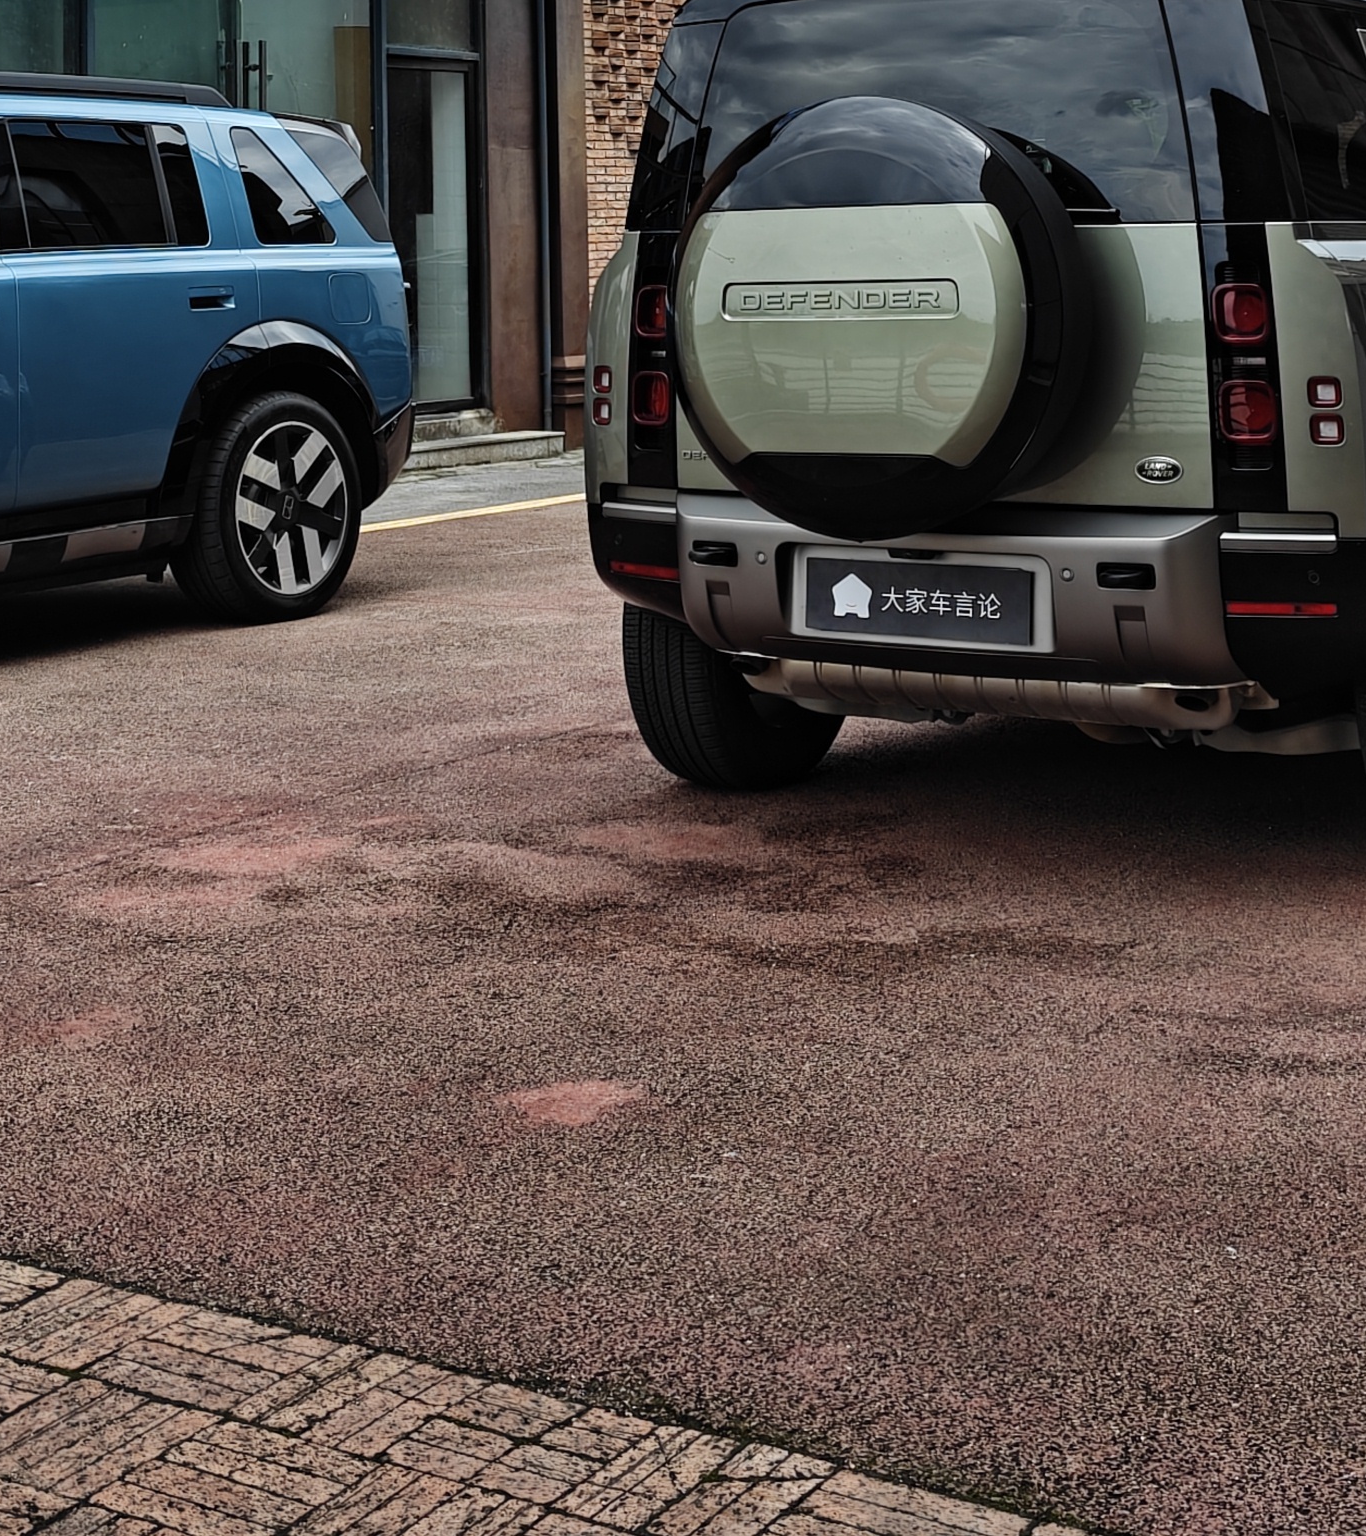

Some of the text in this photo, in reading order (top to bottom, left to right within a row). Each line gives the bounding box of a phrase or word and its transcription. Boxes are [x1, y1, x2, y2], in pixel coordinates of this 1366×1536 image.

[739, 289, 941, 312] DEFENDER
[881, 586, 1002, 620] 大家车言论
